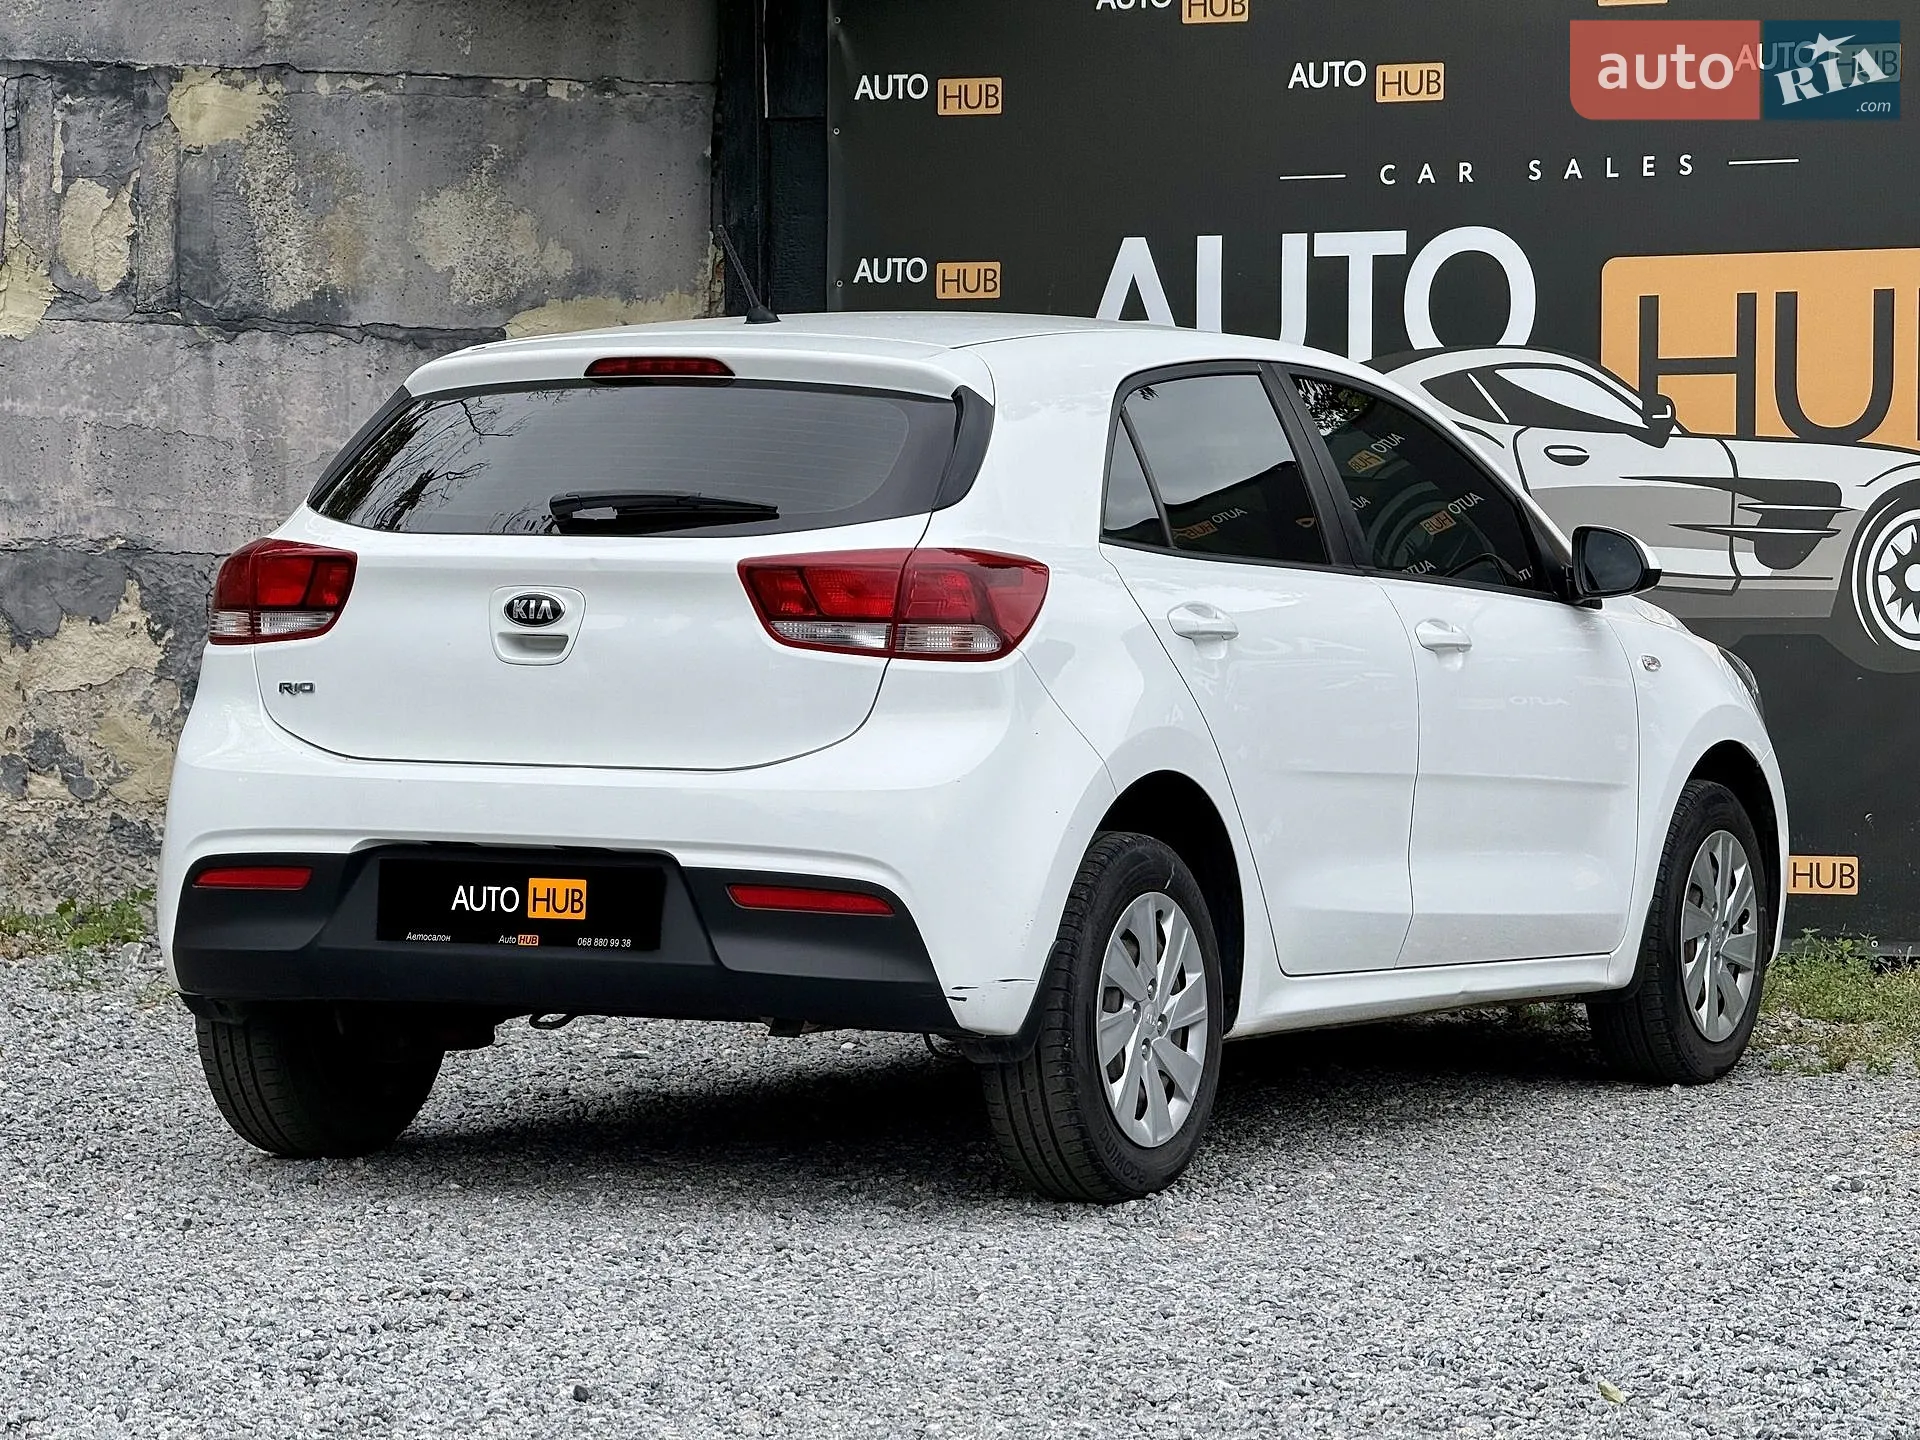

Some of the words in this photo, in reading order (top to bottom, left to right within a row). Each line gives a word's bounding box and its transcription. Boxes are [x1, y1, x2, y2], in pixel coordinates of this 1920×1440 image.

[854, 73, 929, 101] AUTO
[943, 83, 1000, 110] HUB
[1288, 60, 1367, 89] AUTO
[1382, 69, 1442, 97] HUB
[1379, 161, 1474, 185] CAR
[1528, 154, 1694, 181] SALES
[853, 257, 928, 285] AUTO
[941, 267, 998, 294] HUB
[1096, 226, 1537, 364] AUTO
[1638, 287, 1920, 442] HU
[512, 597, 555, 621] KIA
[278, 682, 316, 697] RIO
[1792, 862, 1856, 890] HUB
[451, 885, 520, 913] AUTO
[532, 887, 584, 914] HUB
[405, 931, 452, 942] Автосалон
[518, 935, 538, 945] HUB
[577, 937, 592, 946] 068
[609, 938, 620, 947] 99
